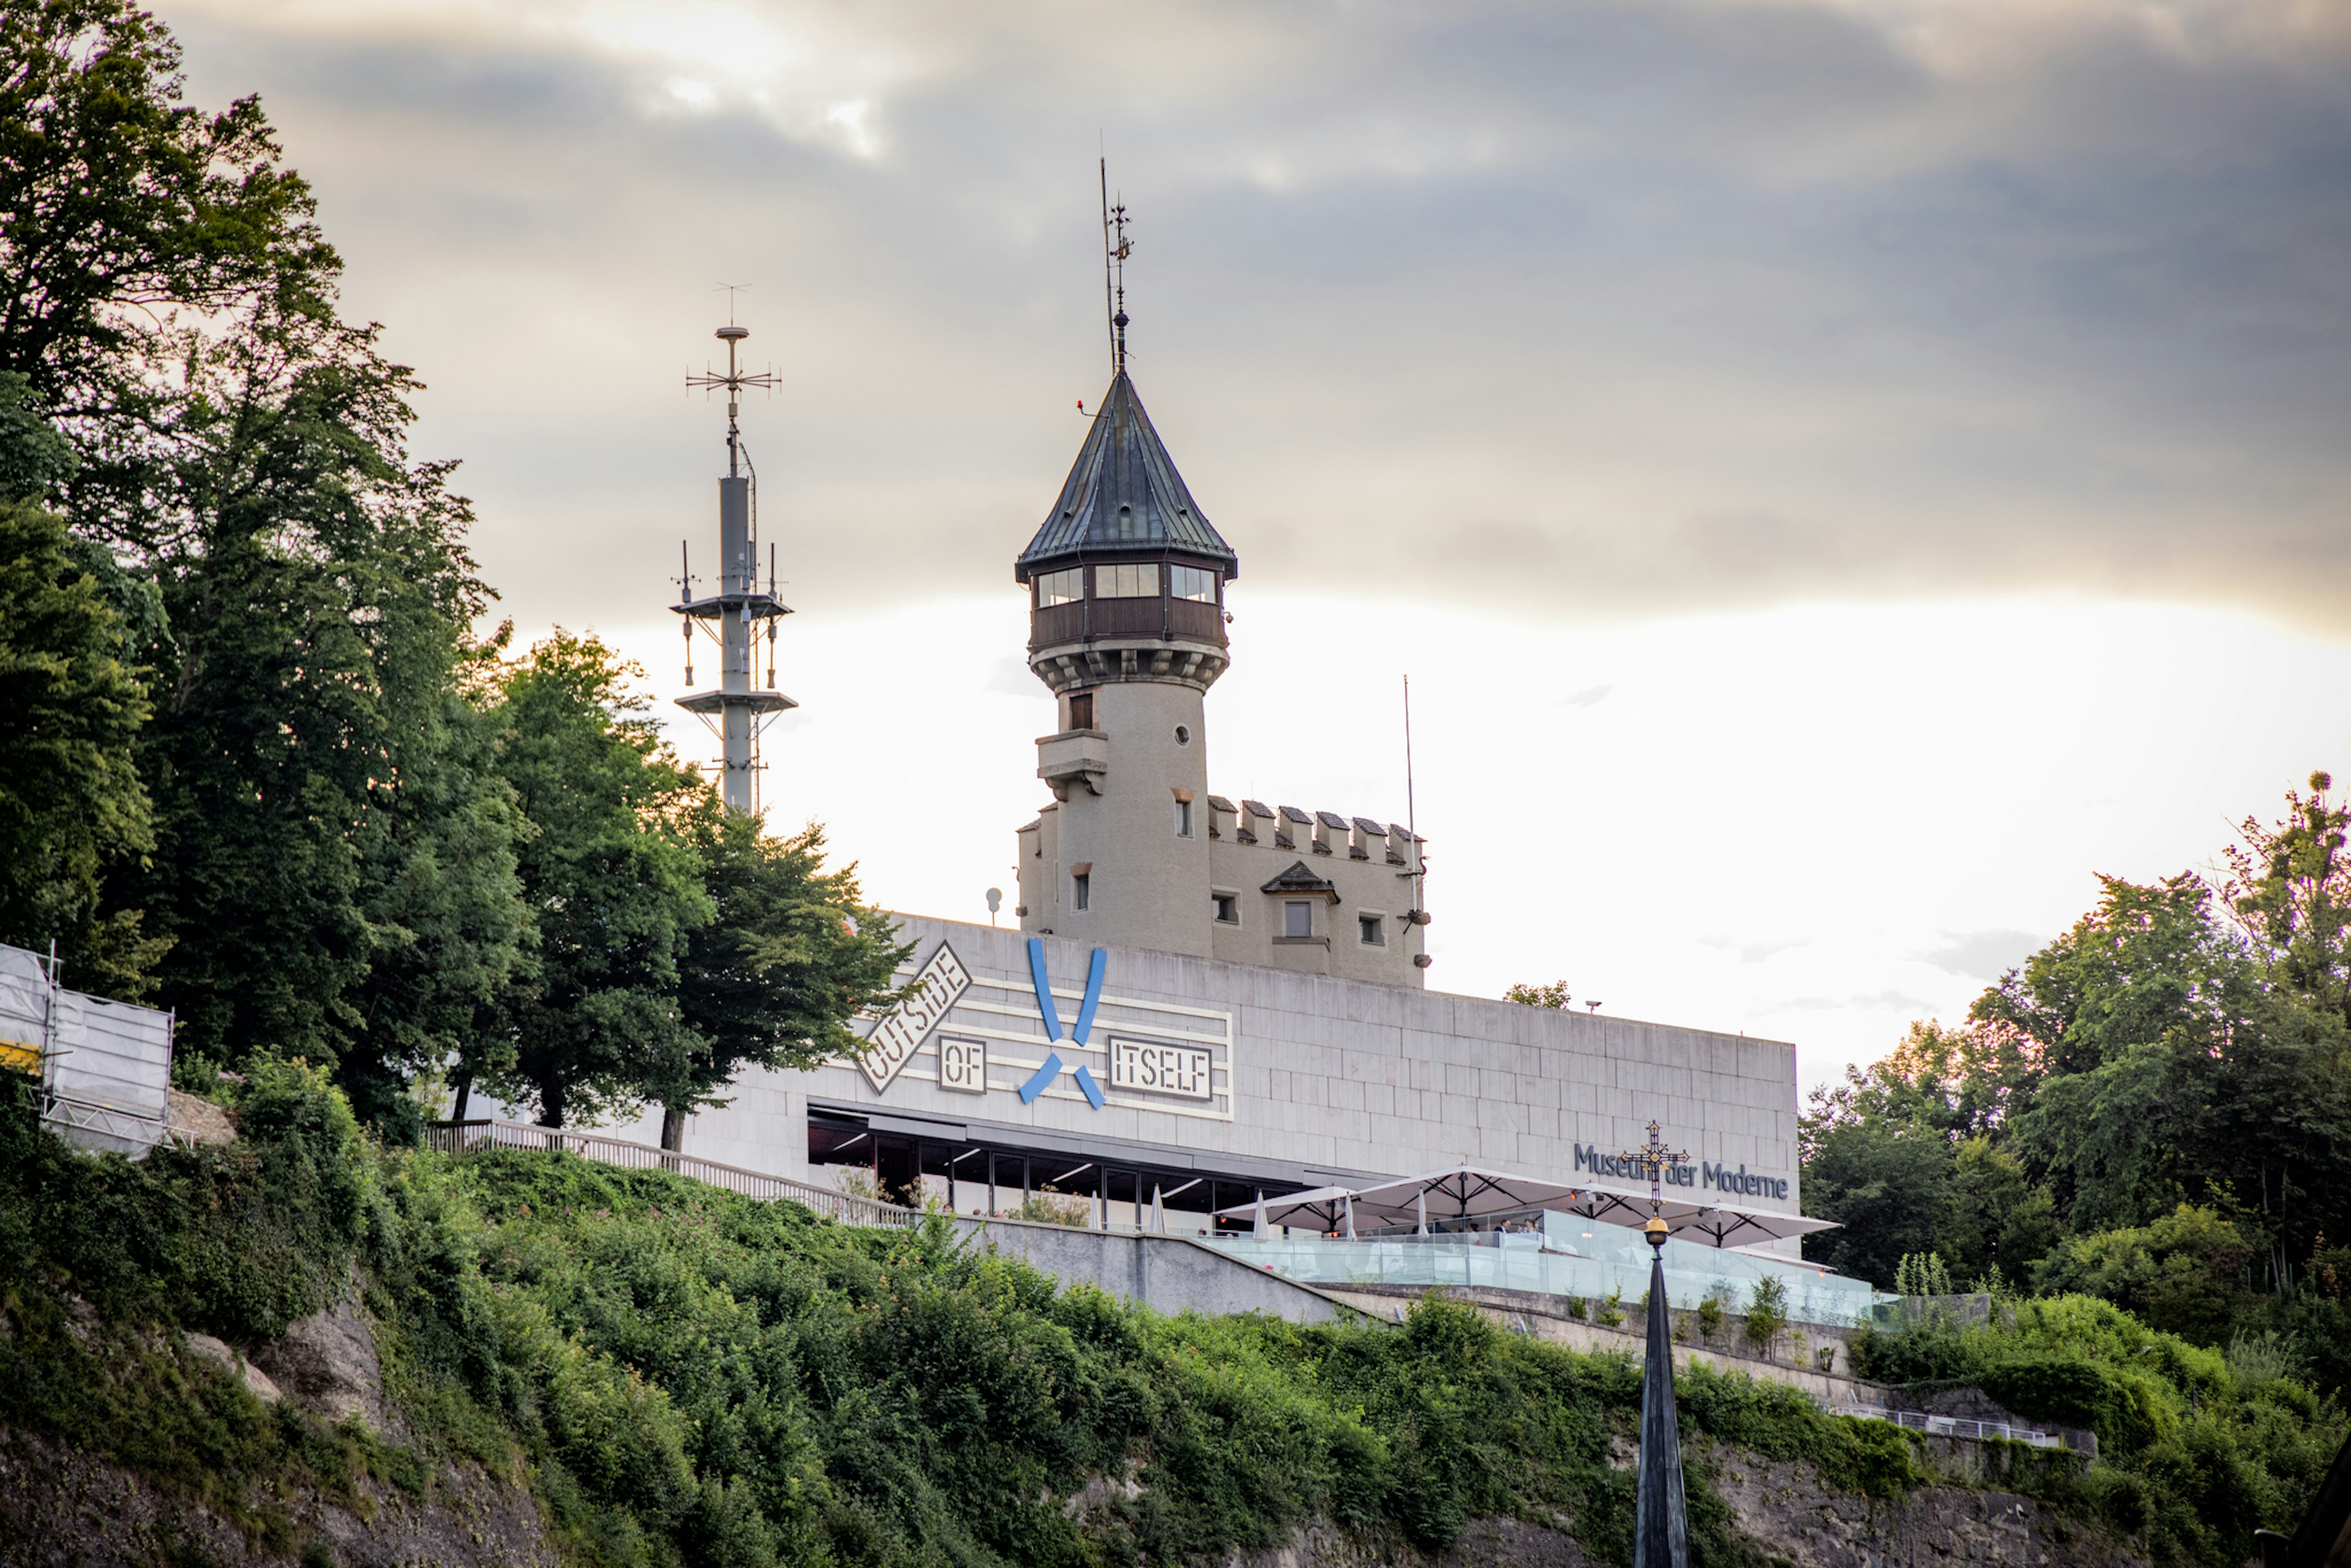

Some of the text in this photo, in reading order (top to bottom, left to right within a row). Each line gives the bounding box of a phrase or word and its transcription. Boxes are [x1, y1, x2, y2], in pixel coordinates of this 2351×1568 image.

[863, 952, 965, 1080] OUTSIDE
[945, 1045, 981, 1085] OF
[1116, 1044, 1205, 1092] ITSELF
[1665, 1153, 1698, 1187] der
[1703, 1161, 1788, 1200] Moderne
